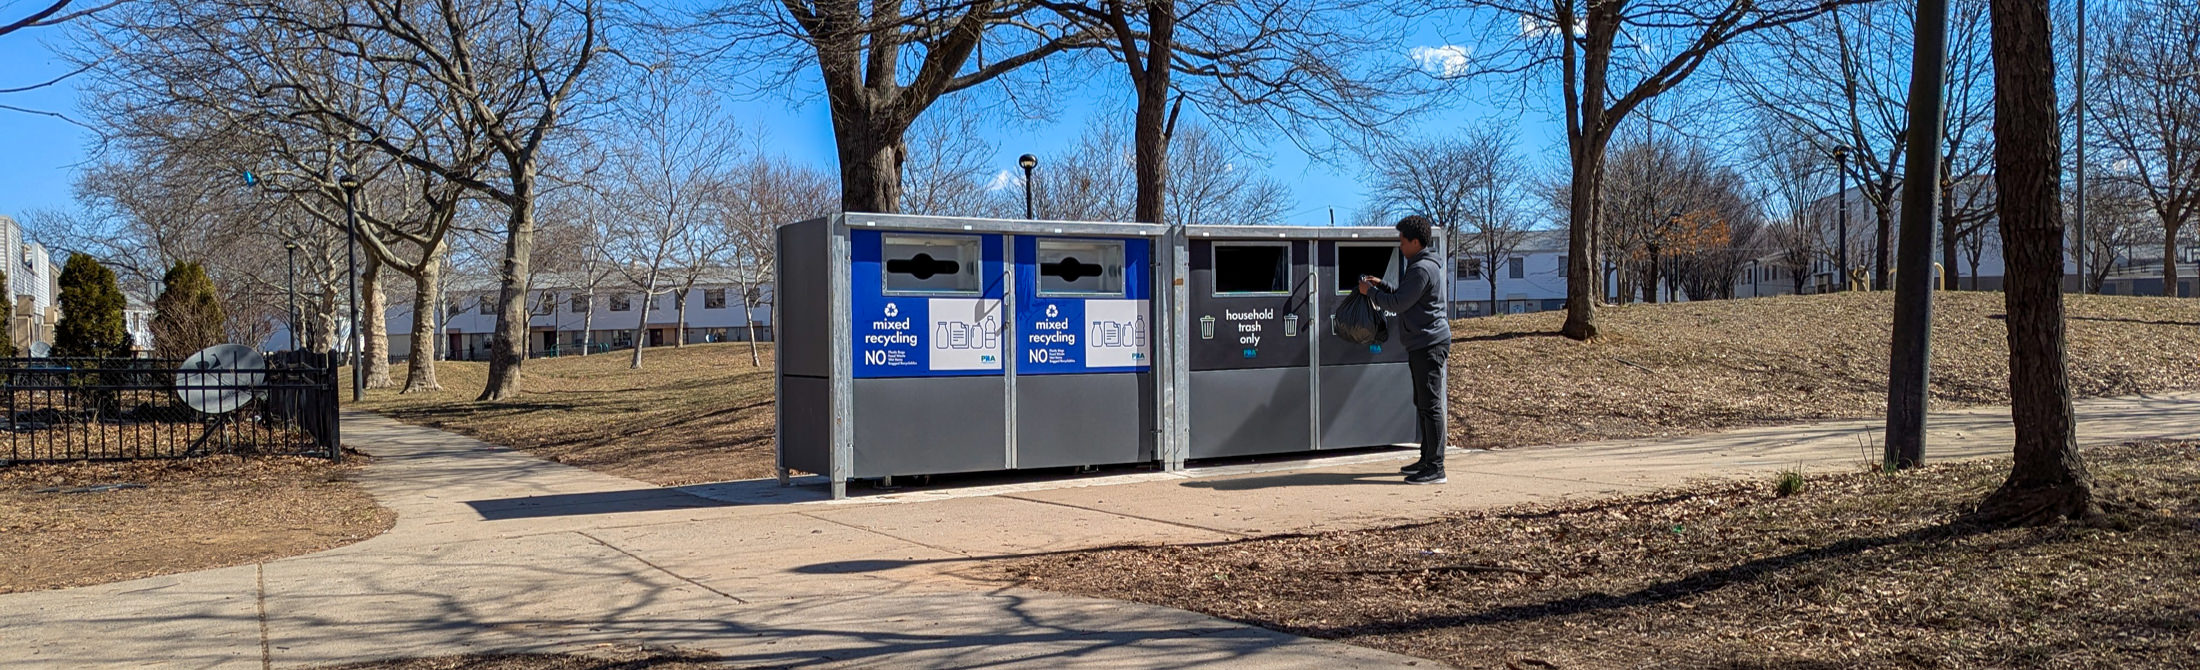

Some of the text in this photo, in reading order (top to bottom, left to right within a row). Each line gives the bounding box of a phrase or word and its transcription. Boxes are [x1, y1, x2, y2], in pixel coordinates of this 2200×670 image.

[1226, 308, 1274, 320] household
[873, 317, 910, 330] mixed
[1036, 317, 1068, 330] mixed
[1238, 320, 1262, 332] trash
[865, 331, 918, 347] recycling
[1029, 330, 1075, 346] recycling
[1239, 332, 1261, 347] only
[865, 350, 886, 365] NO
[1029, 349, 1048, 363] NO
